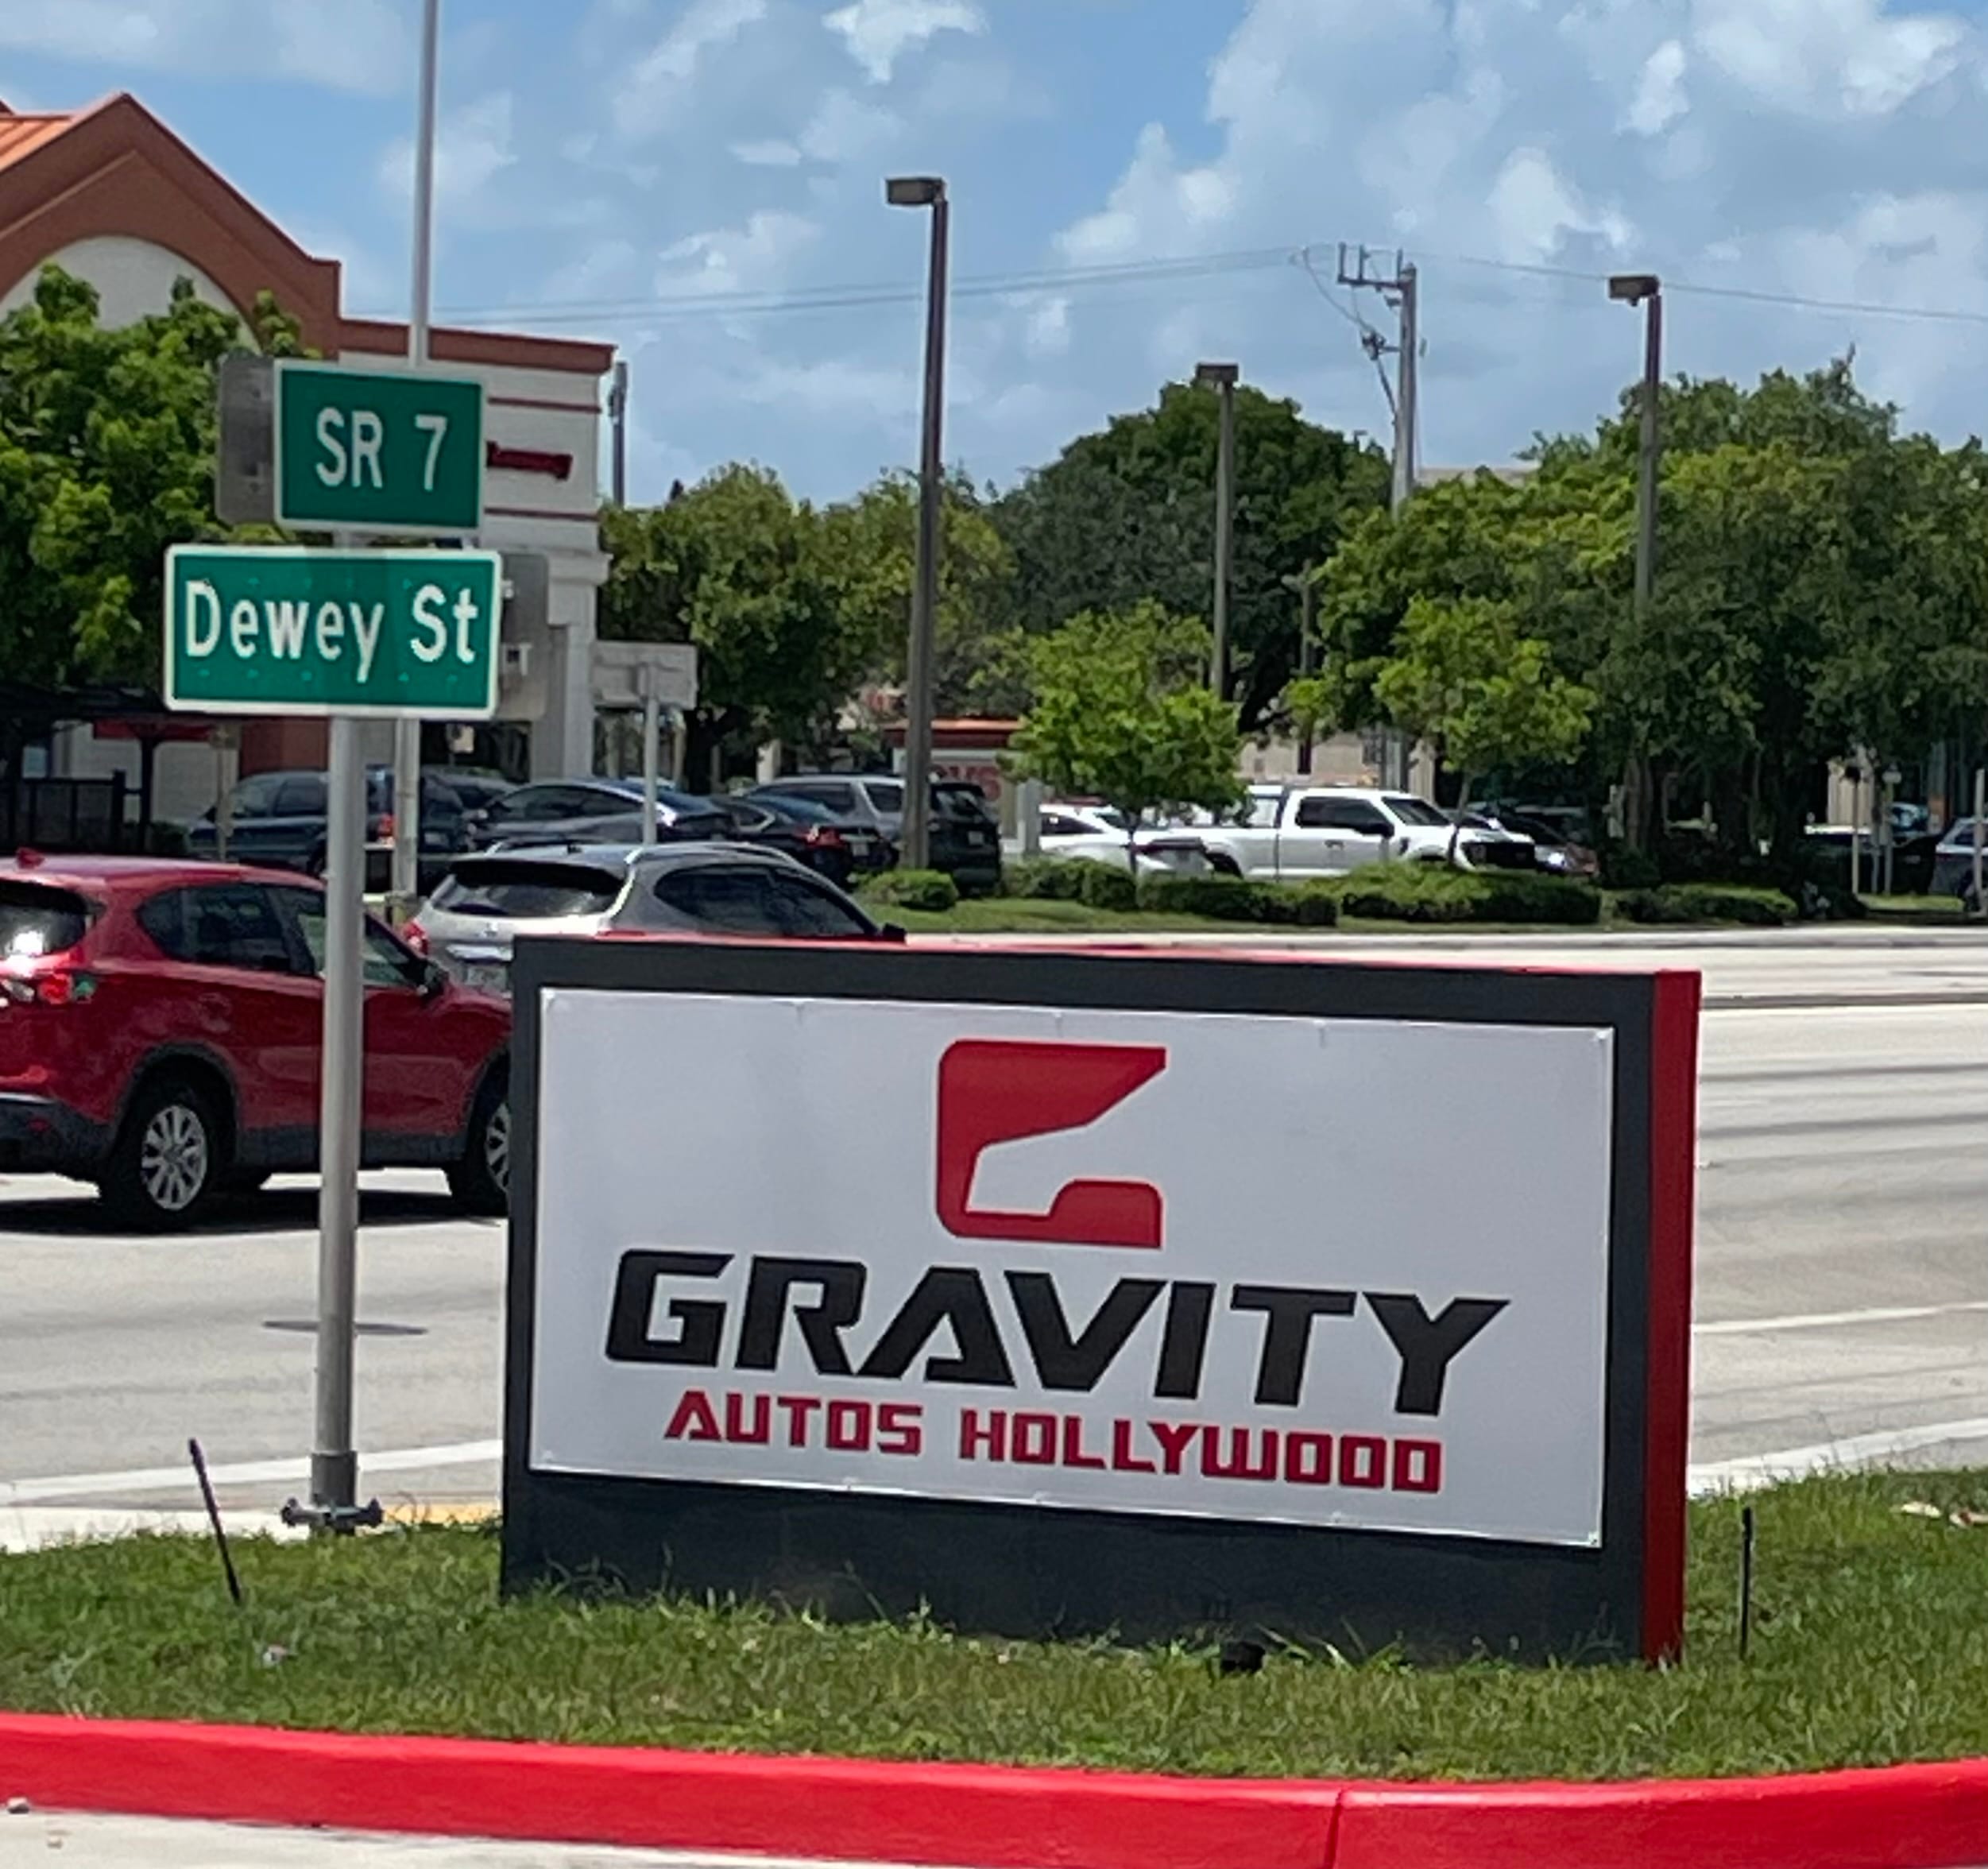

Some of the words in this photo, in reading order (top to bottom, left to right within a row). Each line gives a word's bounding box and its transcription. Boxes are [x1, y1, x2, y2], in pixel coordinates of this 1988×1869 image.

[316, 407, 383, 488] SR
[416, 415, 447, 490] 7
[185, 579, 385, 683] Dewey
[410, 584, 478, 664] St
[604, 1248, 1511, 1418] GRAVITY
[664, 1389, 923, 1456] AUTOS
[958, 1408, 1443, 1493] HOLLYWOOD
